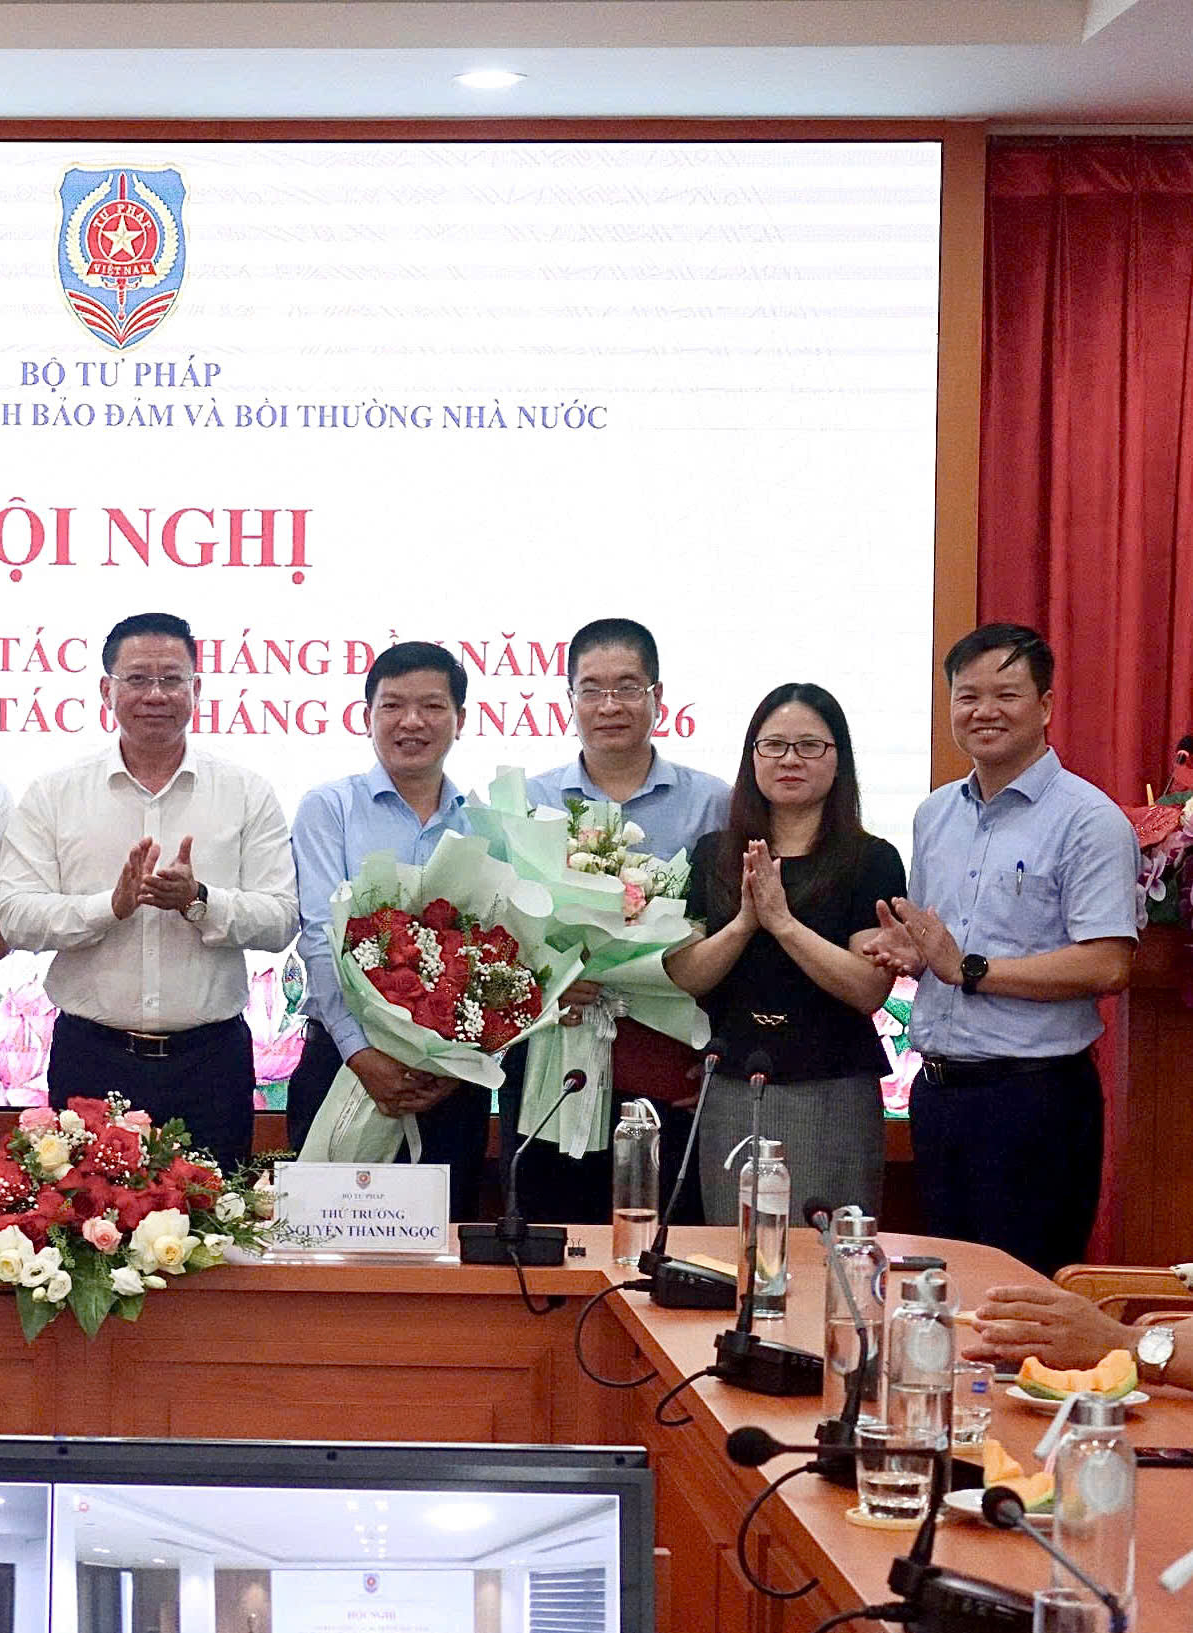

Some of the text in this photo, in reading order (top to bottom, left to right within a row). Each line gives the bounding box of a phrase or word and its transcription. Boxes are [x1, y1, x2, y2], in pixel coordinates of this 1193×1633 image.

[20, 354, 222, 393] BỘ TƯ PHÁP
[31, 397, 96, 427] BẢO
[104, 397, 174, 427] ĐẢM
[183, 399, 224, 428] VÀ
[297, 397, 432, 429] THƯỜNG
[442, 398, 508, 430] NHÀ
[517, 398, 608, 430] NƯỚC
[101, 506, 313, 585] NGHỊ
[194, 628, 331, 675] HÁNG
[458, 631, 569, 677] NĂM
[191, 688, 330, 735] HÁNG
[399, 1225, 440, 1241] NGỌC
